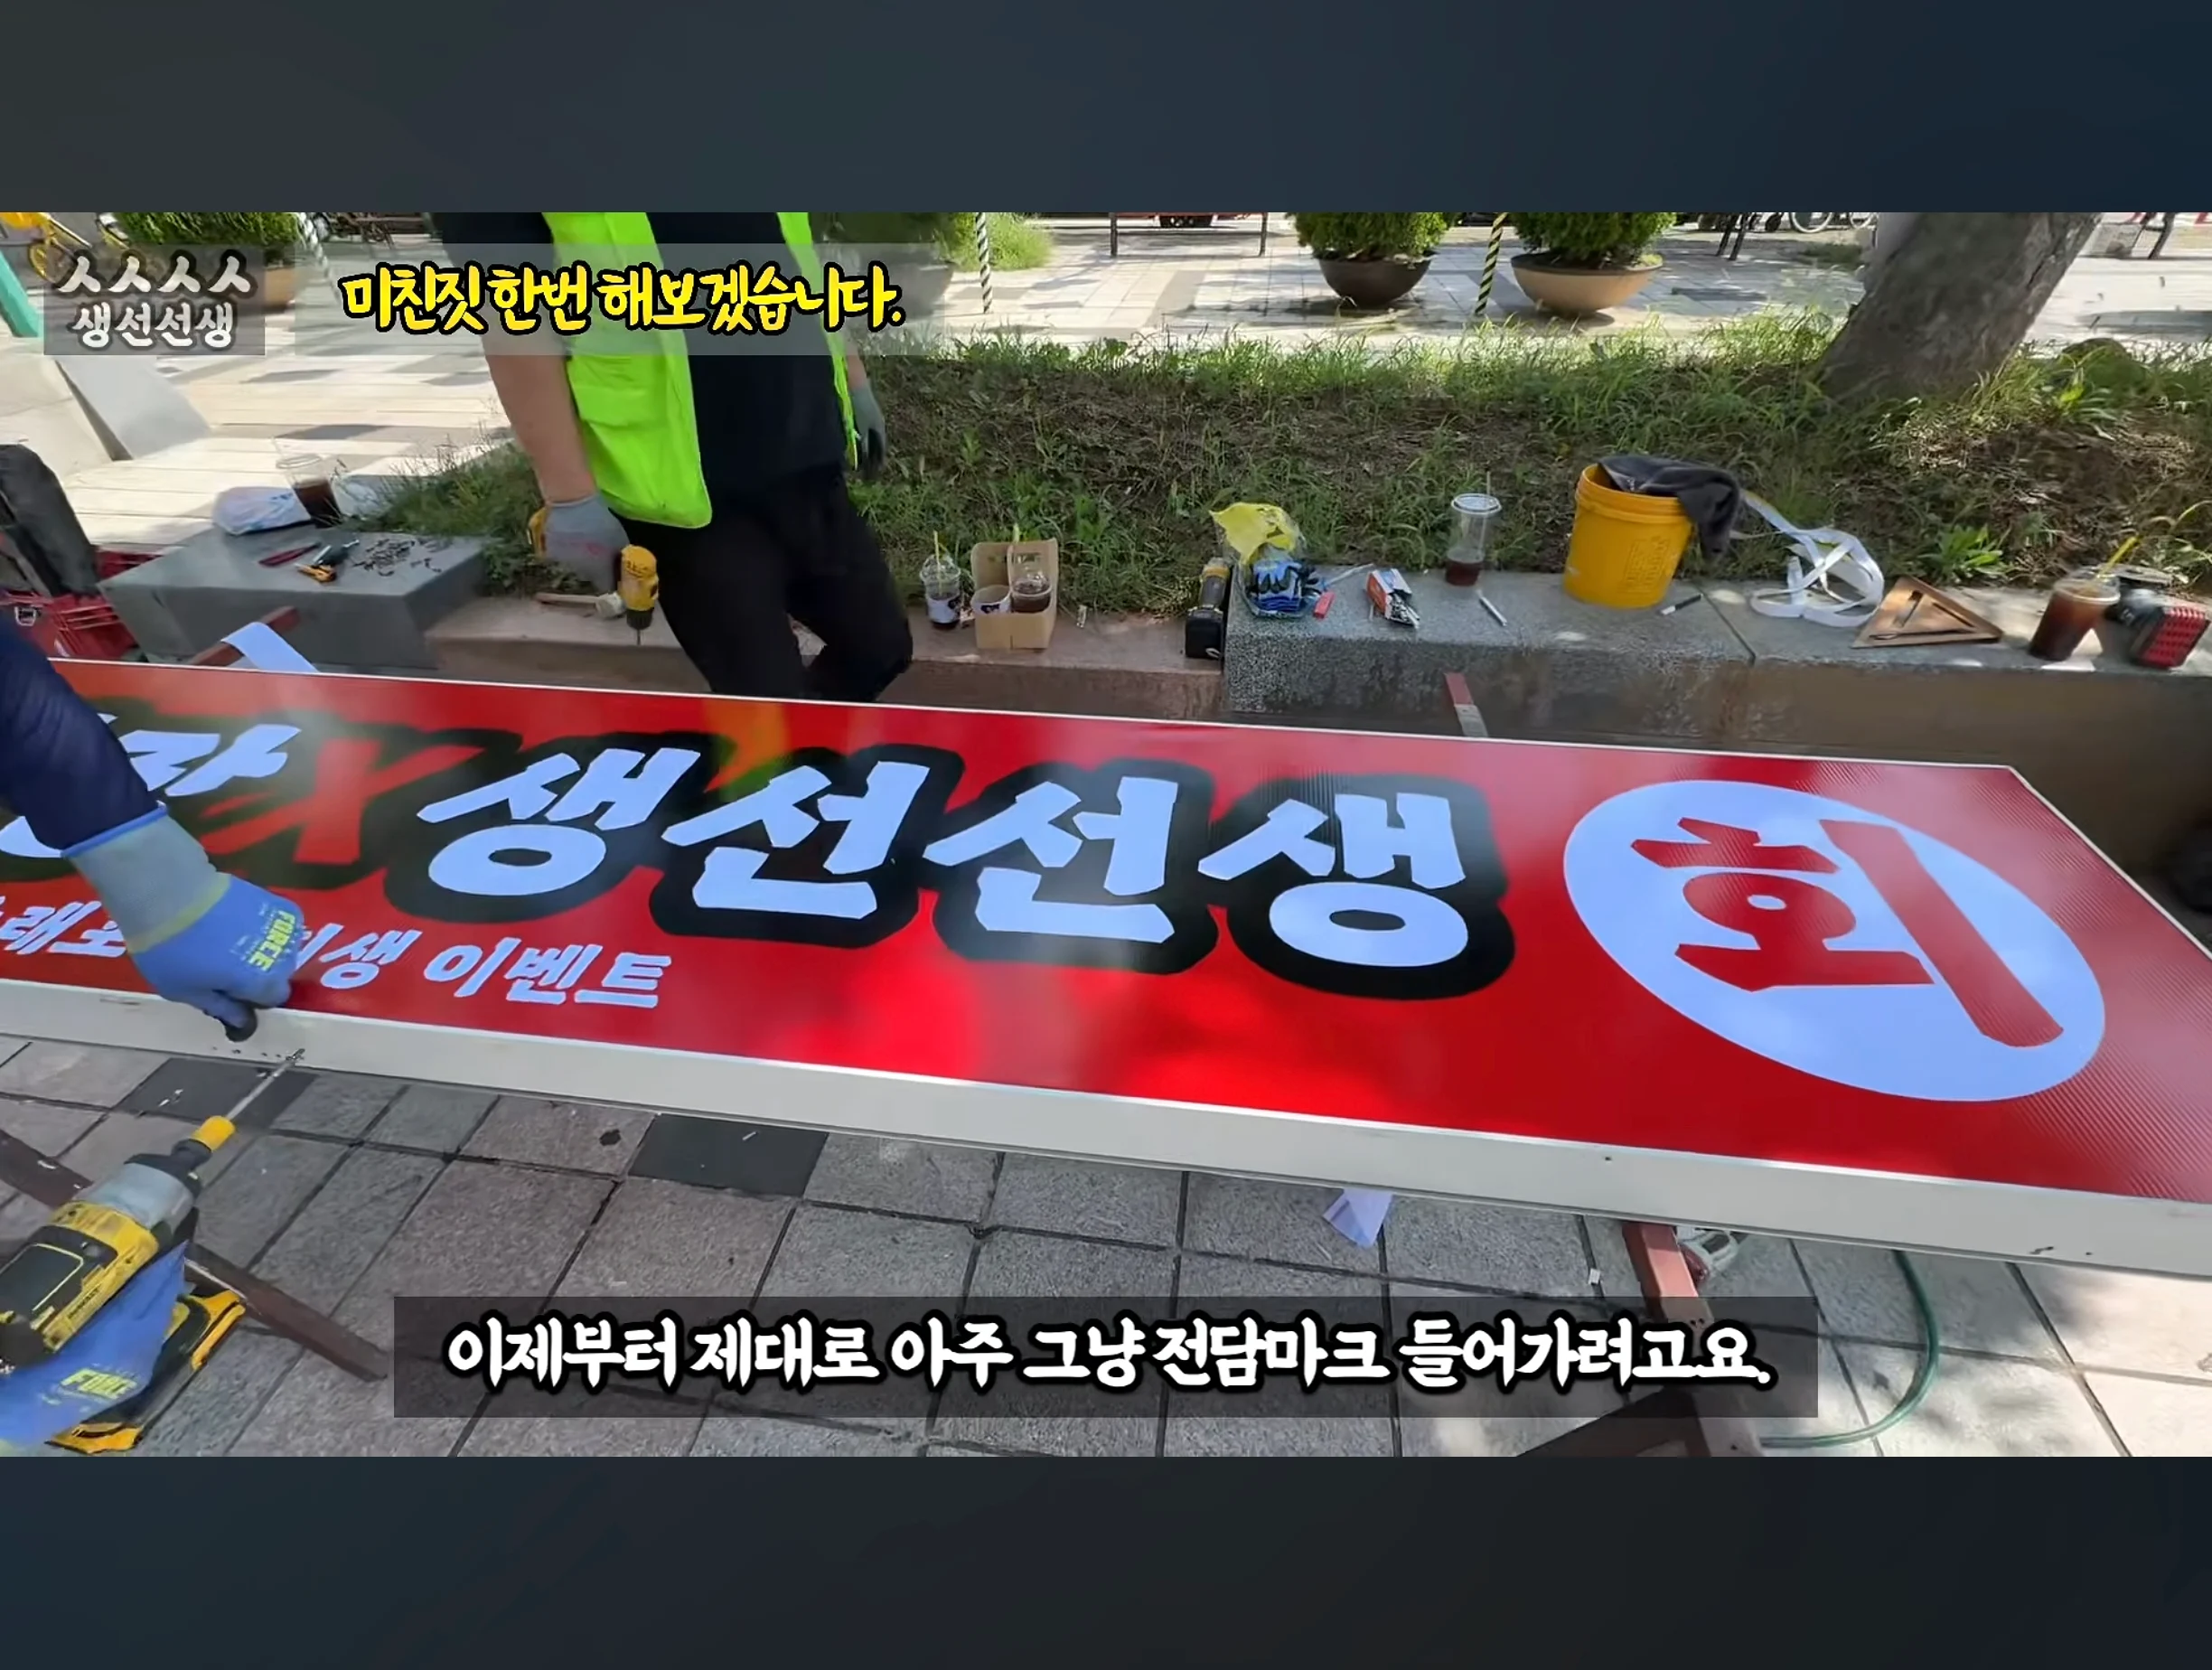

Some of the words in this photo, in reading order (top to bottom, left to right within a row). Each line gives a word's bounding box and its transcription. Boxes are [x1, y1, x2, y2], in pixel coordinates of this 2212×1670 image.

[416, 748, 1467, 968] 생선선생
[248, 909, 296, 971] FORCE
[424, 937, 671, 1009] 이벤트
[1631, 816, 2064, 1049] 회
